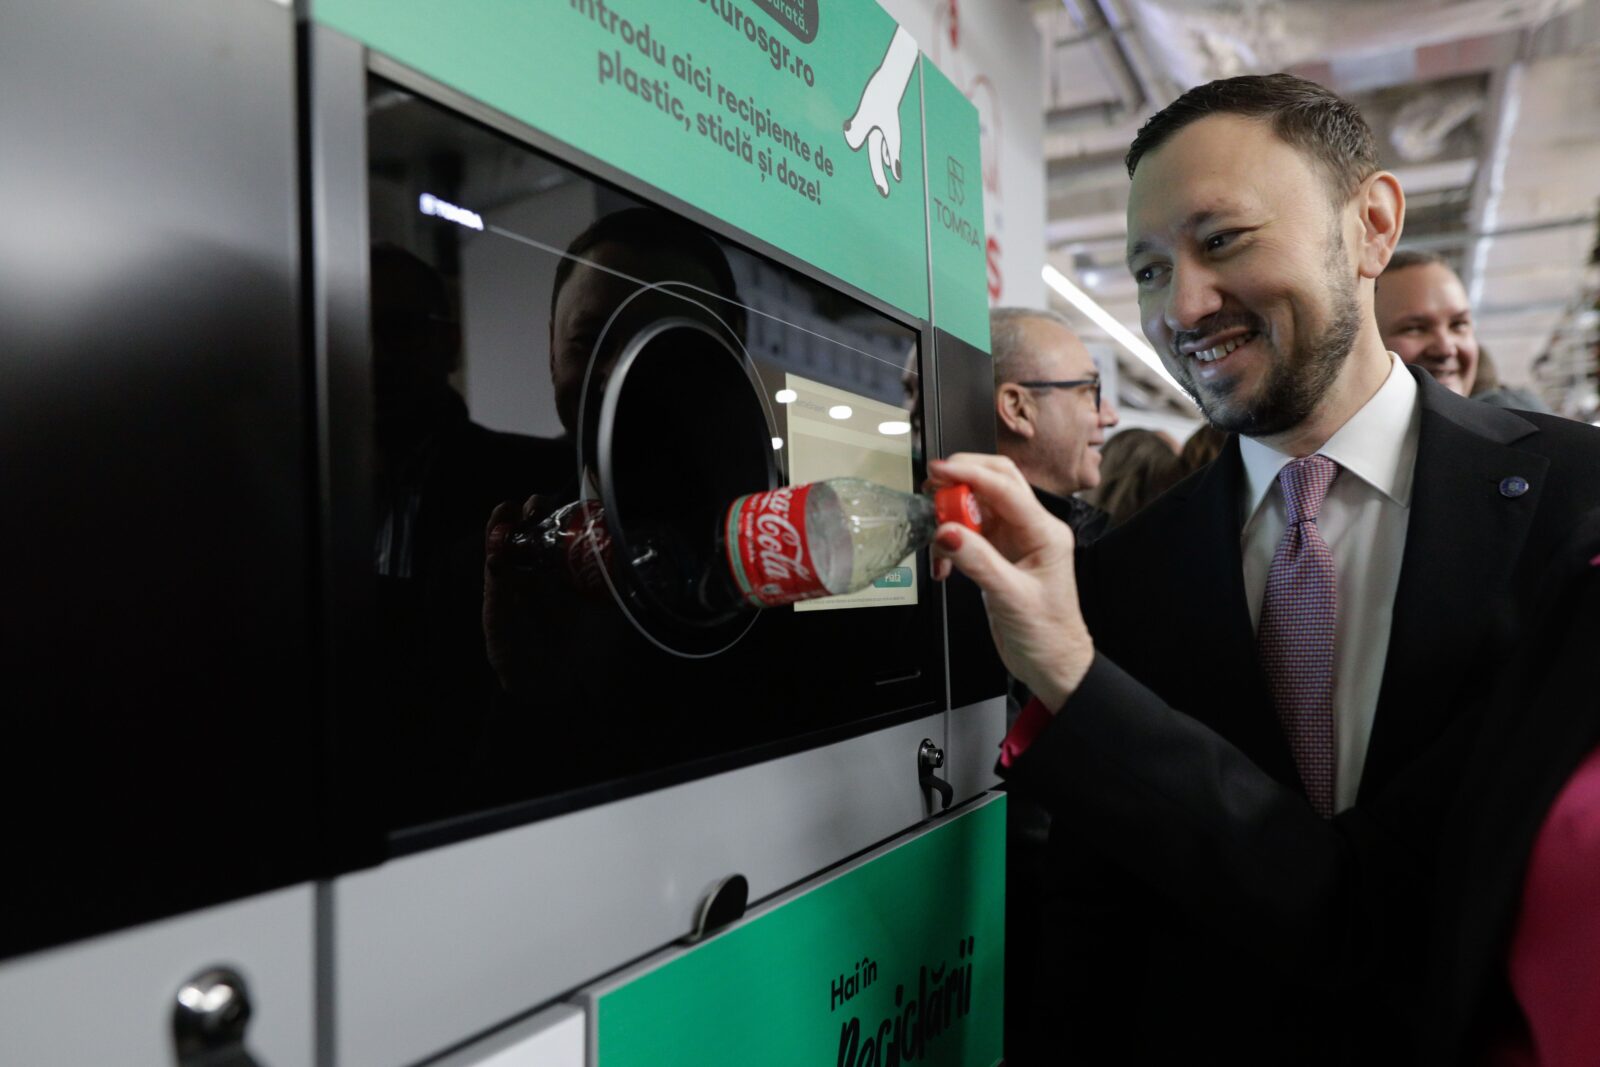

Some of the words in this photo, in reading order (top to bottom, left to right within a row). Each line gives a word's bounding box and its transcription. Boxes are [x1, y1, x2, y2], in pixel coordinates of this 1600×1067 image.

[767, 0, 809, 35] urată.
[570, 0, 666, 68] ntrodu
[672, 53, 712, 98] aici
[718, 84, 811, 162] recipiente
[814, 144, 834, 177] de
[598, 50, 692, 132] plastic,
[696, 112, 753, 165] sticlă
[758, 147, 773, 183] și
[776, 157, 822, 206] doze!
[830, 961, 860, 1012] Hai
[860, 957, 878, 989] în
